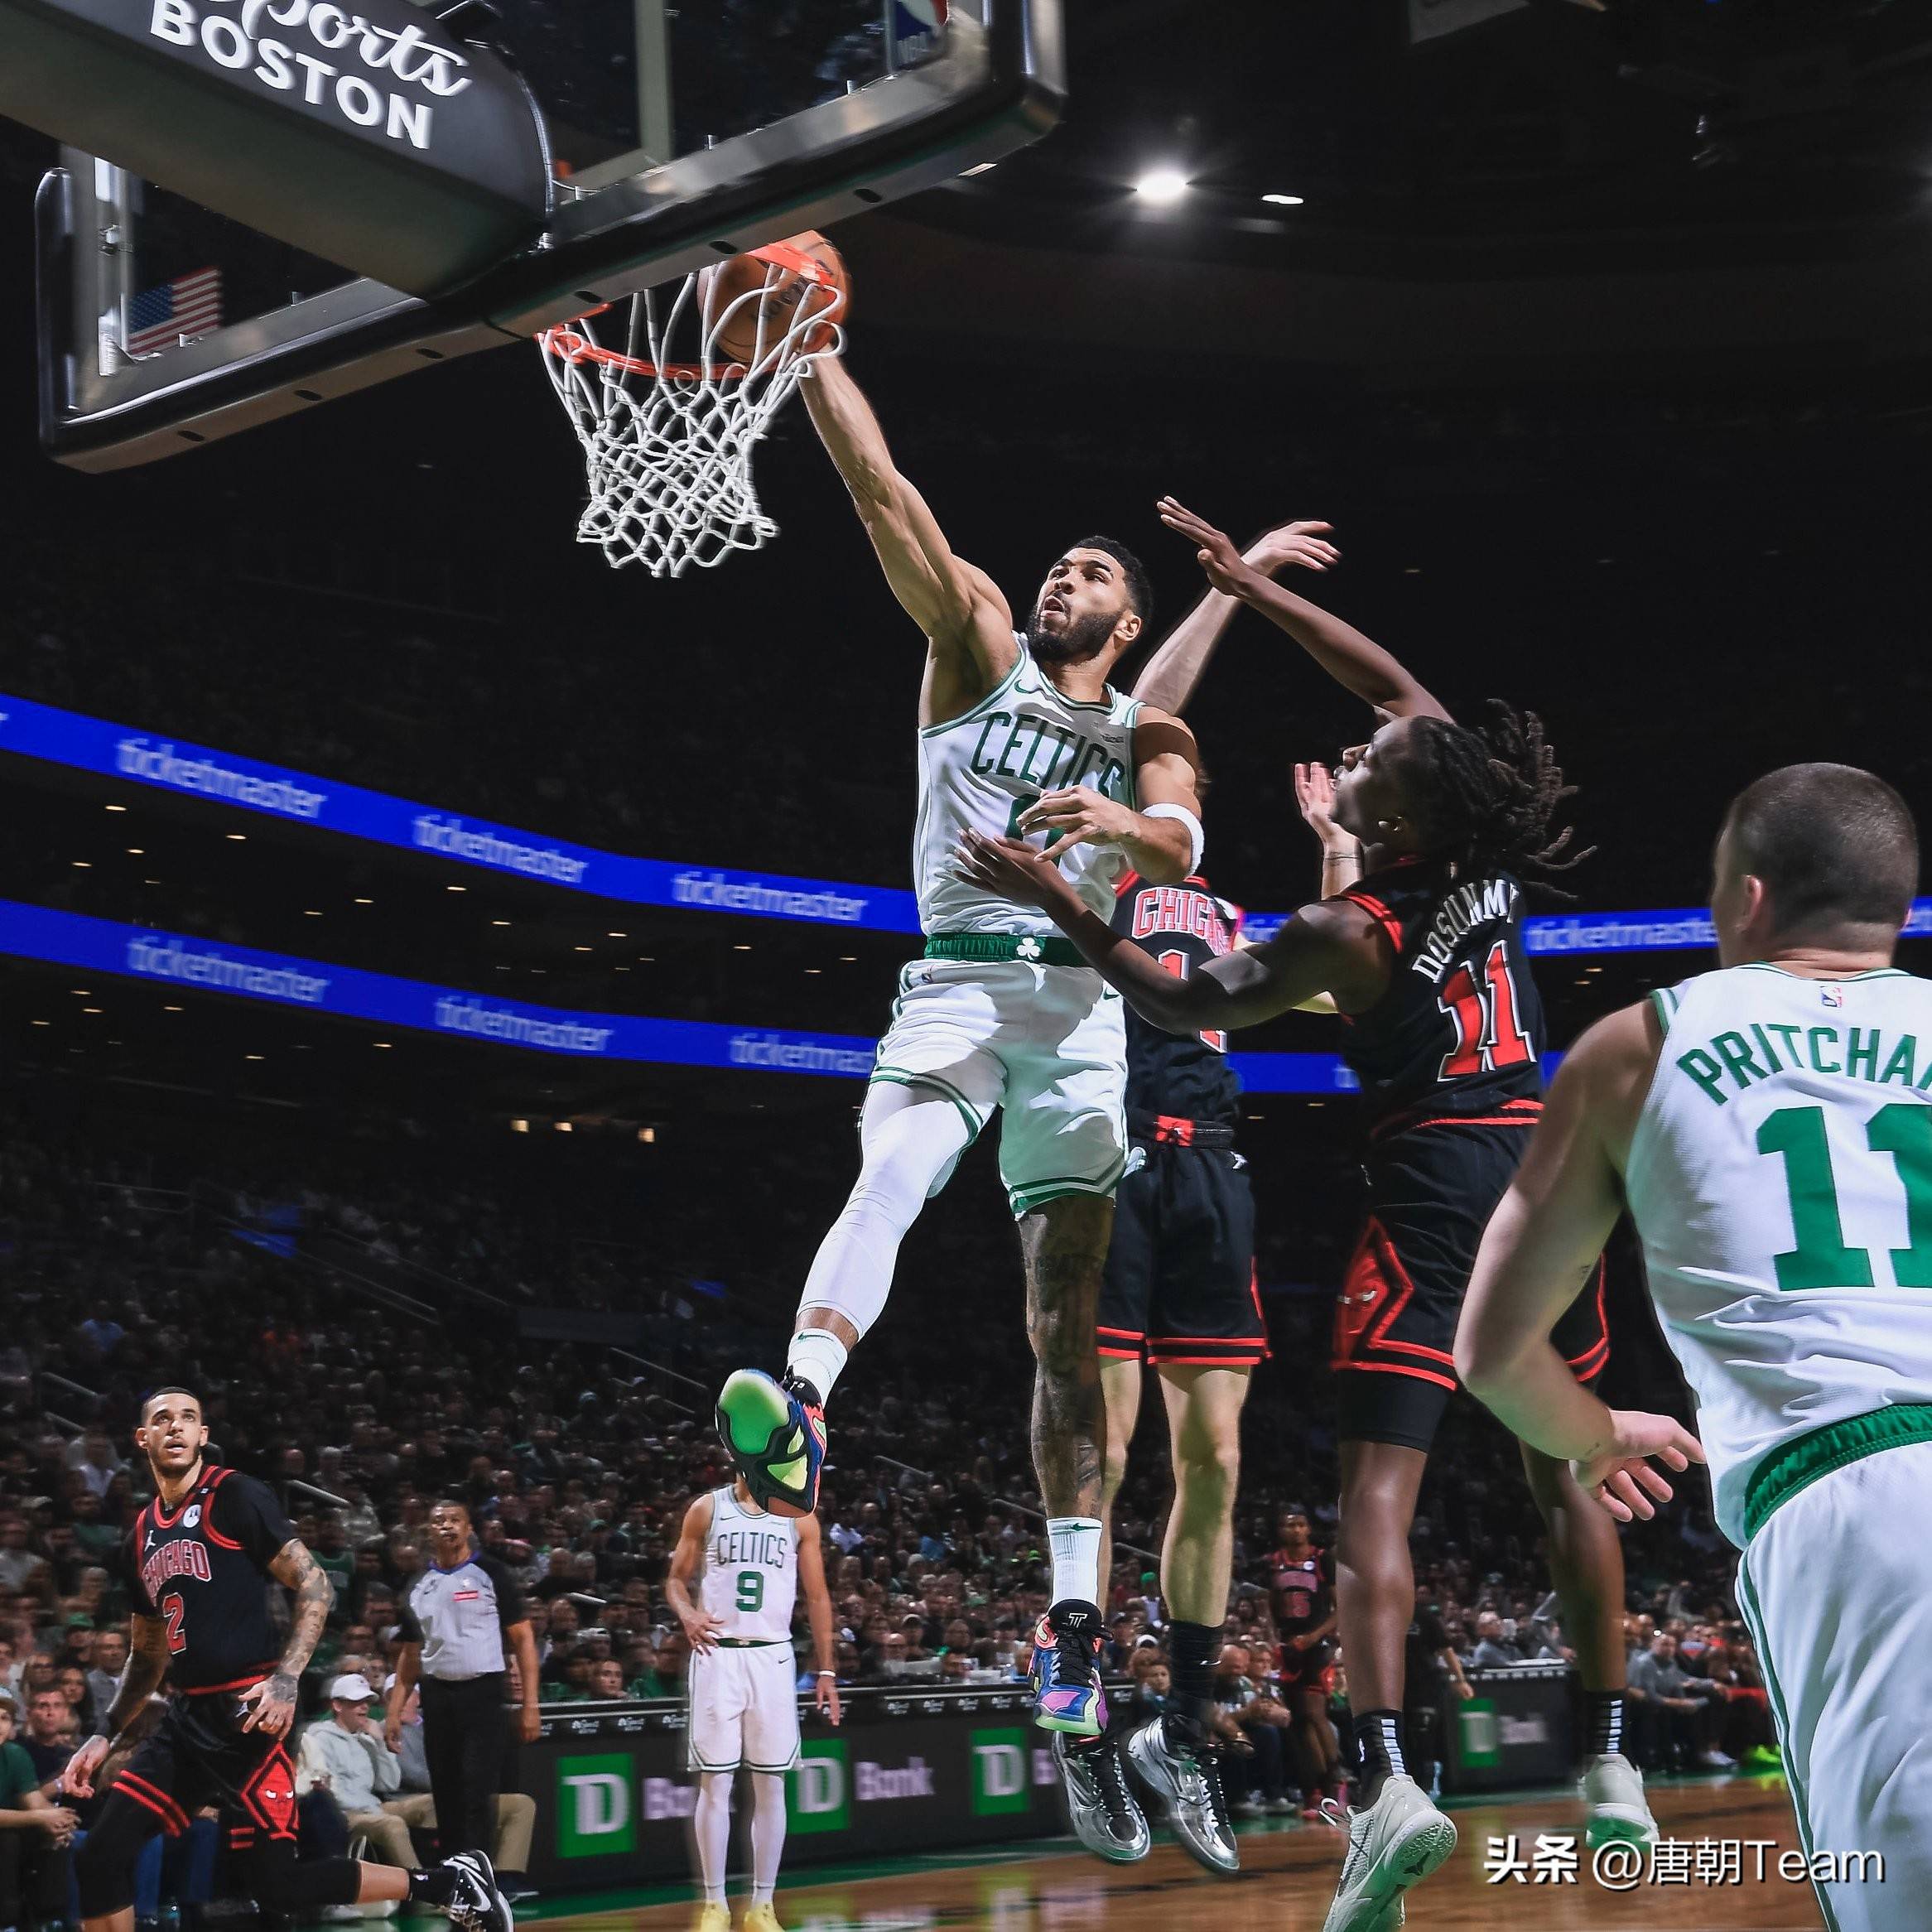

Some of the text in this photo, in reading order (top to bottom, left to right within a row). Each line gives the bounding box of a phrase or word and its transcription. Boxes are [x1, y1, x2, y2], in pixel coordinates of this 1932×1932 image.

[150, 0, 434, 149] BOSTON
[241, 0, 473, 96] ports
[971, 711, 1125, 798] CELTICS
[671, 870, 869, 922] ticketmaster
[1525, 918, 1719, 951] ticketmaste
[1437, 939, 1537, 1082] 11
[1677, 1024, 1932, 1106] PRITCHA
[1756, 1103, 1932, 1291] 11
[717, 1531, 788, 1569] CELTICS
[735, 1570, 764, 1612] 9
[162, 1592, 187, 1655] 2
[793, 1756, 936, 1814] TD Bank
[972, 1744, 1026, 1796] TD
[562, 1772, 629, 1834] TD
